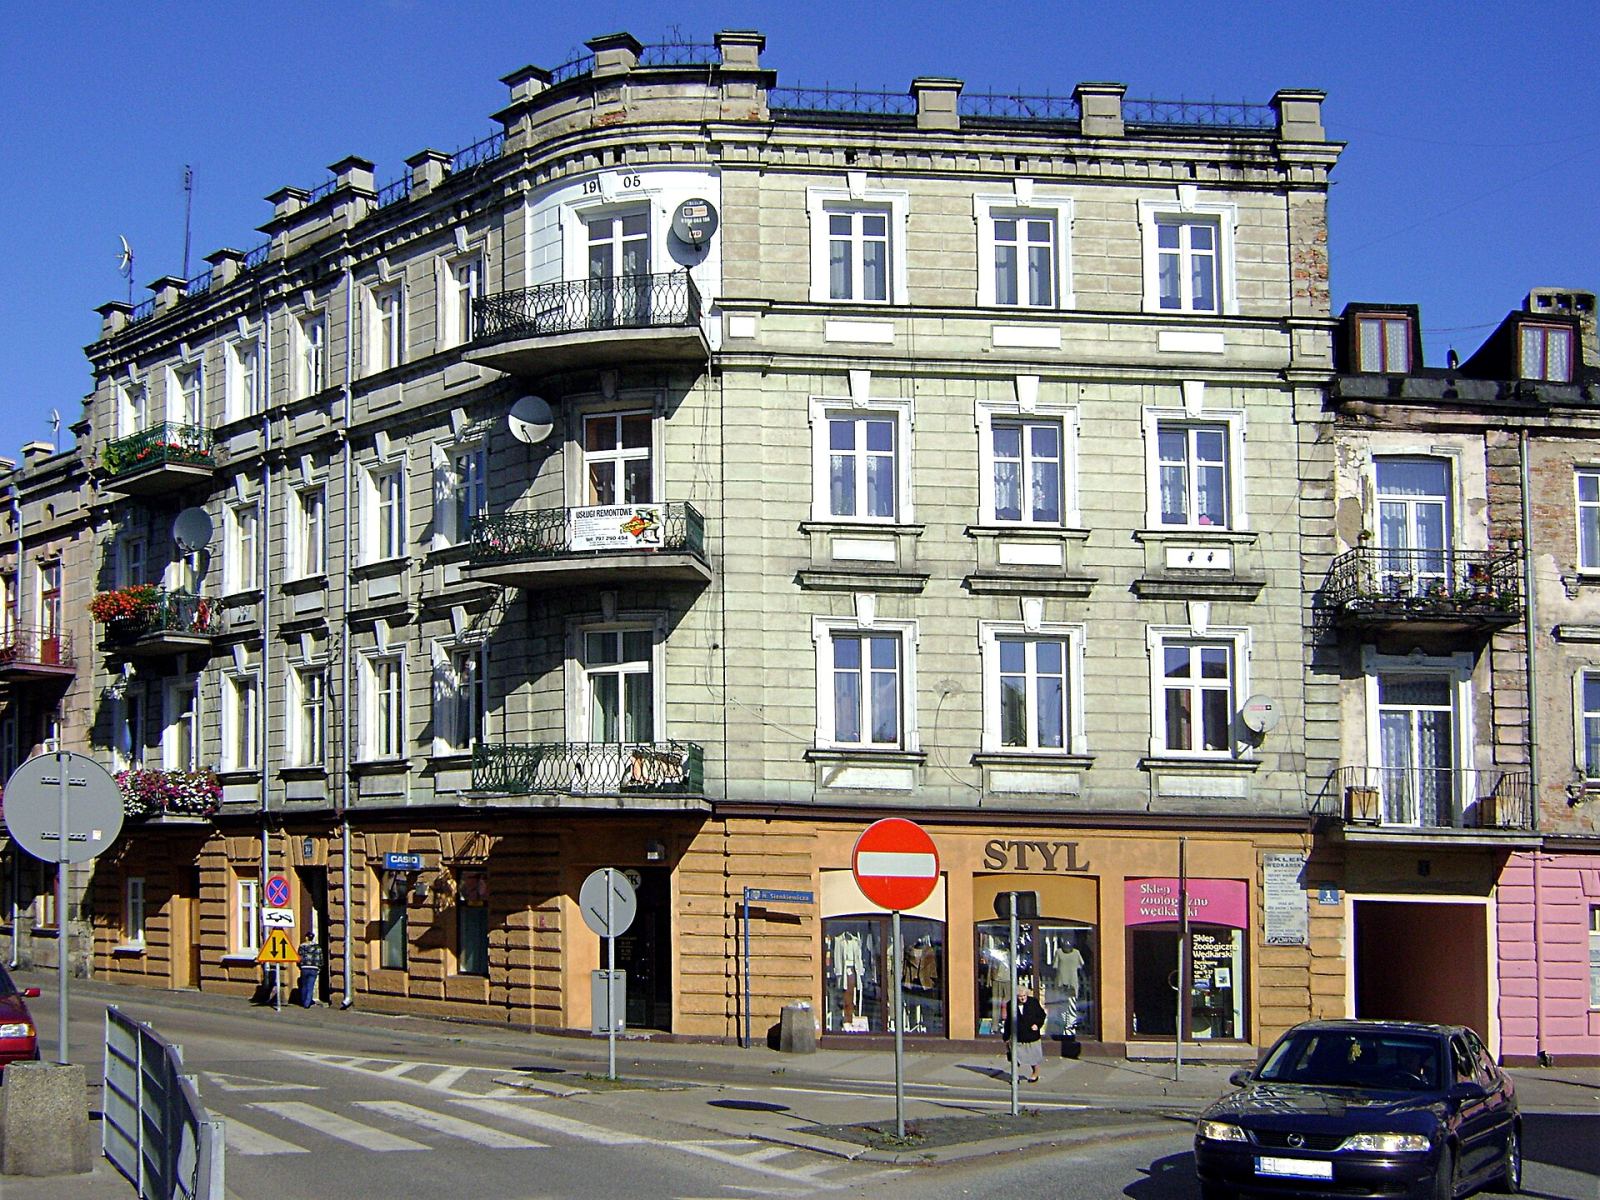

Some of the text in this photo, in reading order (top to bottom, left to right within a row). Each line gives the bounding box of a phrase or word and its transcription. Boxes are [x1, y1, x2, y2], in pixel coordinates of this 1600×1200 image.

[623, 175, 641, 188] 05
[596, 508, 632, 517] REMONTOWE
[390, 855, 419, 864] CASIO
[983, 839, 1090, 872] STYL
[1140, 883, 1171, 896] Sklep
[1193, 934, 1215, 943] Sklep
